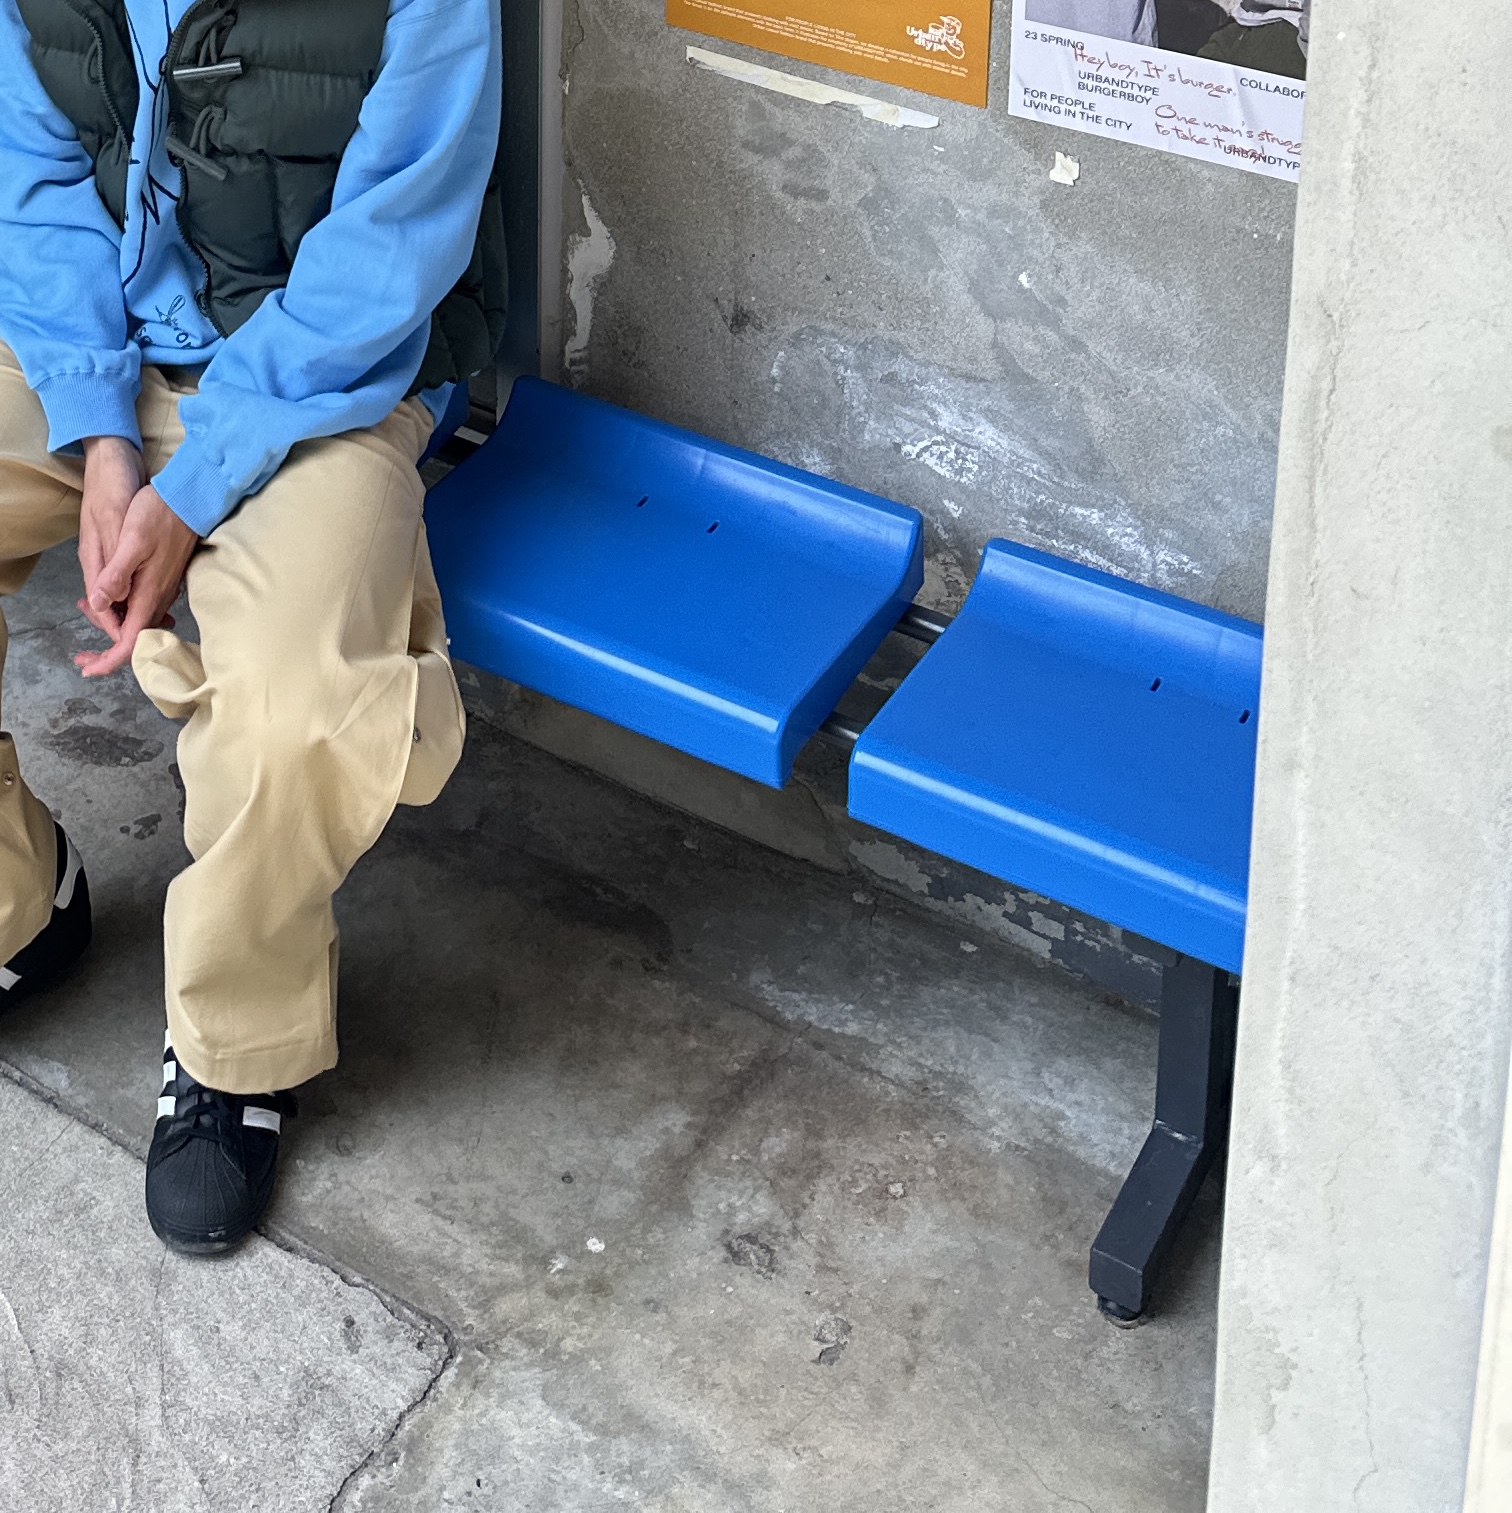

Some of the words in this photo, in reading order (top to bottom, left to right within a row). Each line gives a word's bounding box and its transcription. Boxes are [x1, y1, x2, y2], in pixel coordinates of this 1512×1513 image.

[1024, 30, 1038, 40] 23
[1040, 33, 1084, 50] SPRING
[1074, 46, 1106, 72] Hey
[1140, 59, 1177, 82] It's
[1078, 70, 1160, 96] URBANDTYPE
[1078, 81, 1152, 106] BURGERBOY
[1024, 88, 1047, 100] FOR
[1050, 94, 1096, 112] PEOPLE
[1023, 98, 1061, 115] LIVING
[1065, 106, 1076, 118] IN
[1080, 110, 1103, 124] THE
[1105, 117, 1132, 131] CITY
[1155, 104, 1200, 125] One
[1204, 120, 1254, 139] man's
[1155, 121, 1170, 136] to
[1172, 126, 1210, 145] take
[1213, 135, 1224, 148] it
